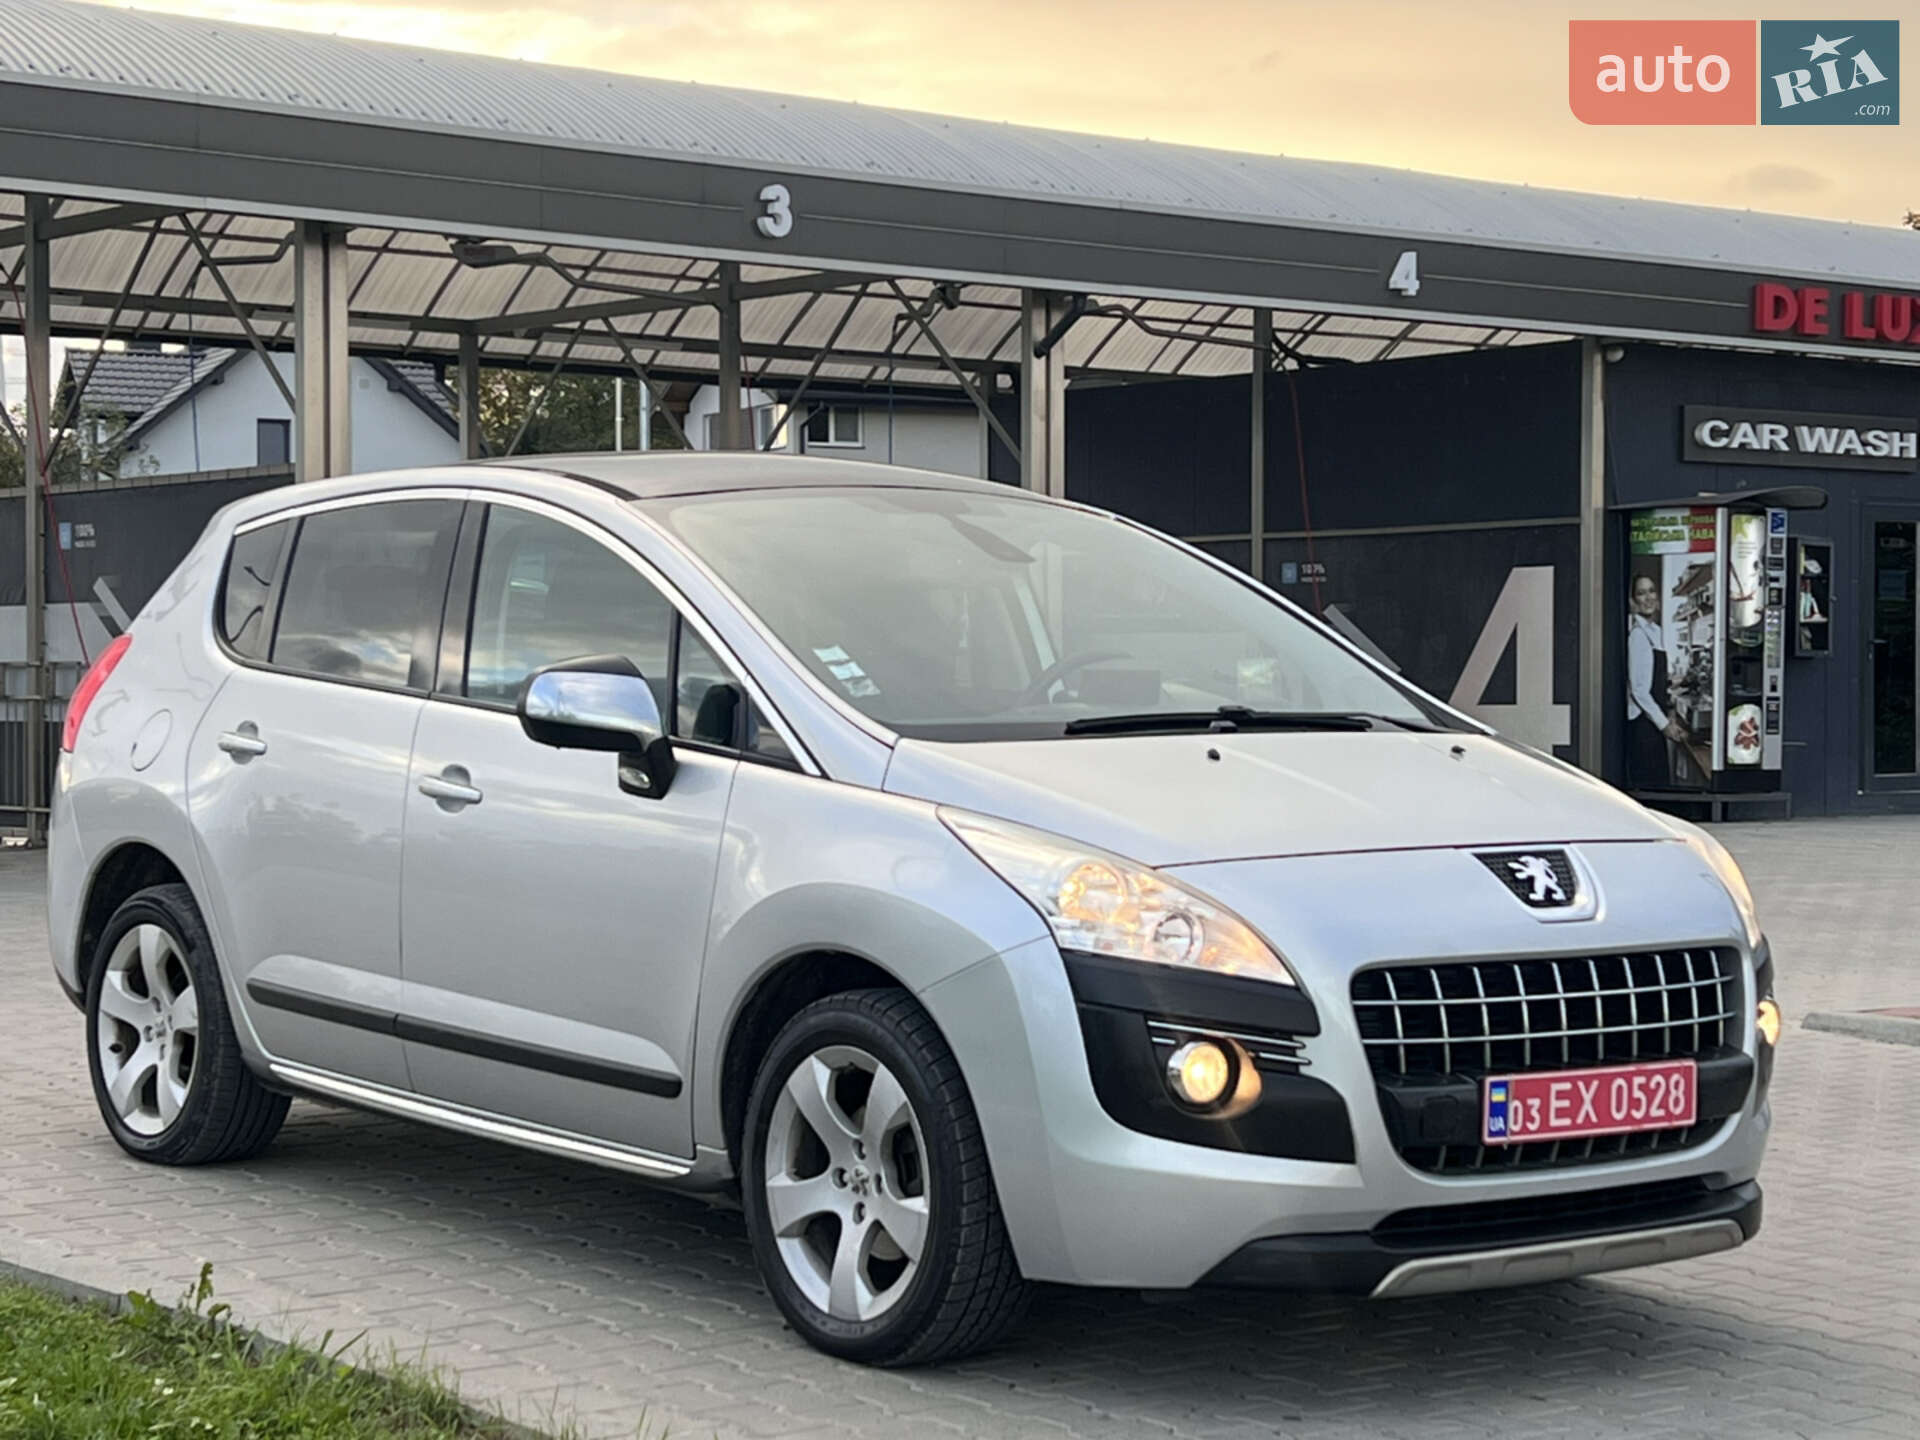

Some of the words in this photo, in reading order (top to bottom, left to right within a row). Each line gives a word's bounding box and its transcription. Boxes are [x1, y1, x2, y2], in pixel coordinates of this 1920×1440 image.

[757, 183, 793, 239] 3
[1388, 250, 1420, 297] 4
[1755, 281, 1830, 336] DE
[1845, 291, 1920, 344] LU
[1694, 419, 1790, 452] CAR
[1794, 425, 1917, 459] WASH
[1448, 565, 1571, 757] 4
[1489, 1116, 1506, 1133] UA
[1549, 1080, 1600, 1128] EX
[1610, 1073, 1686, 1122] 0528
